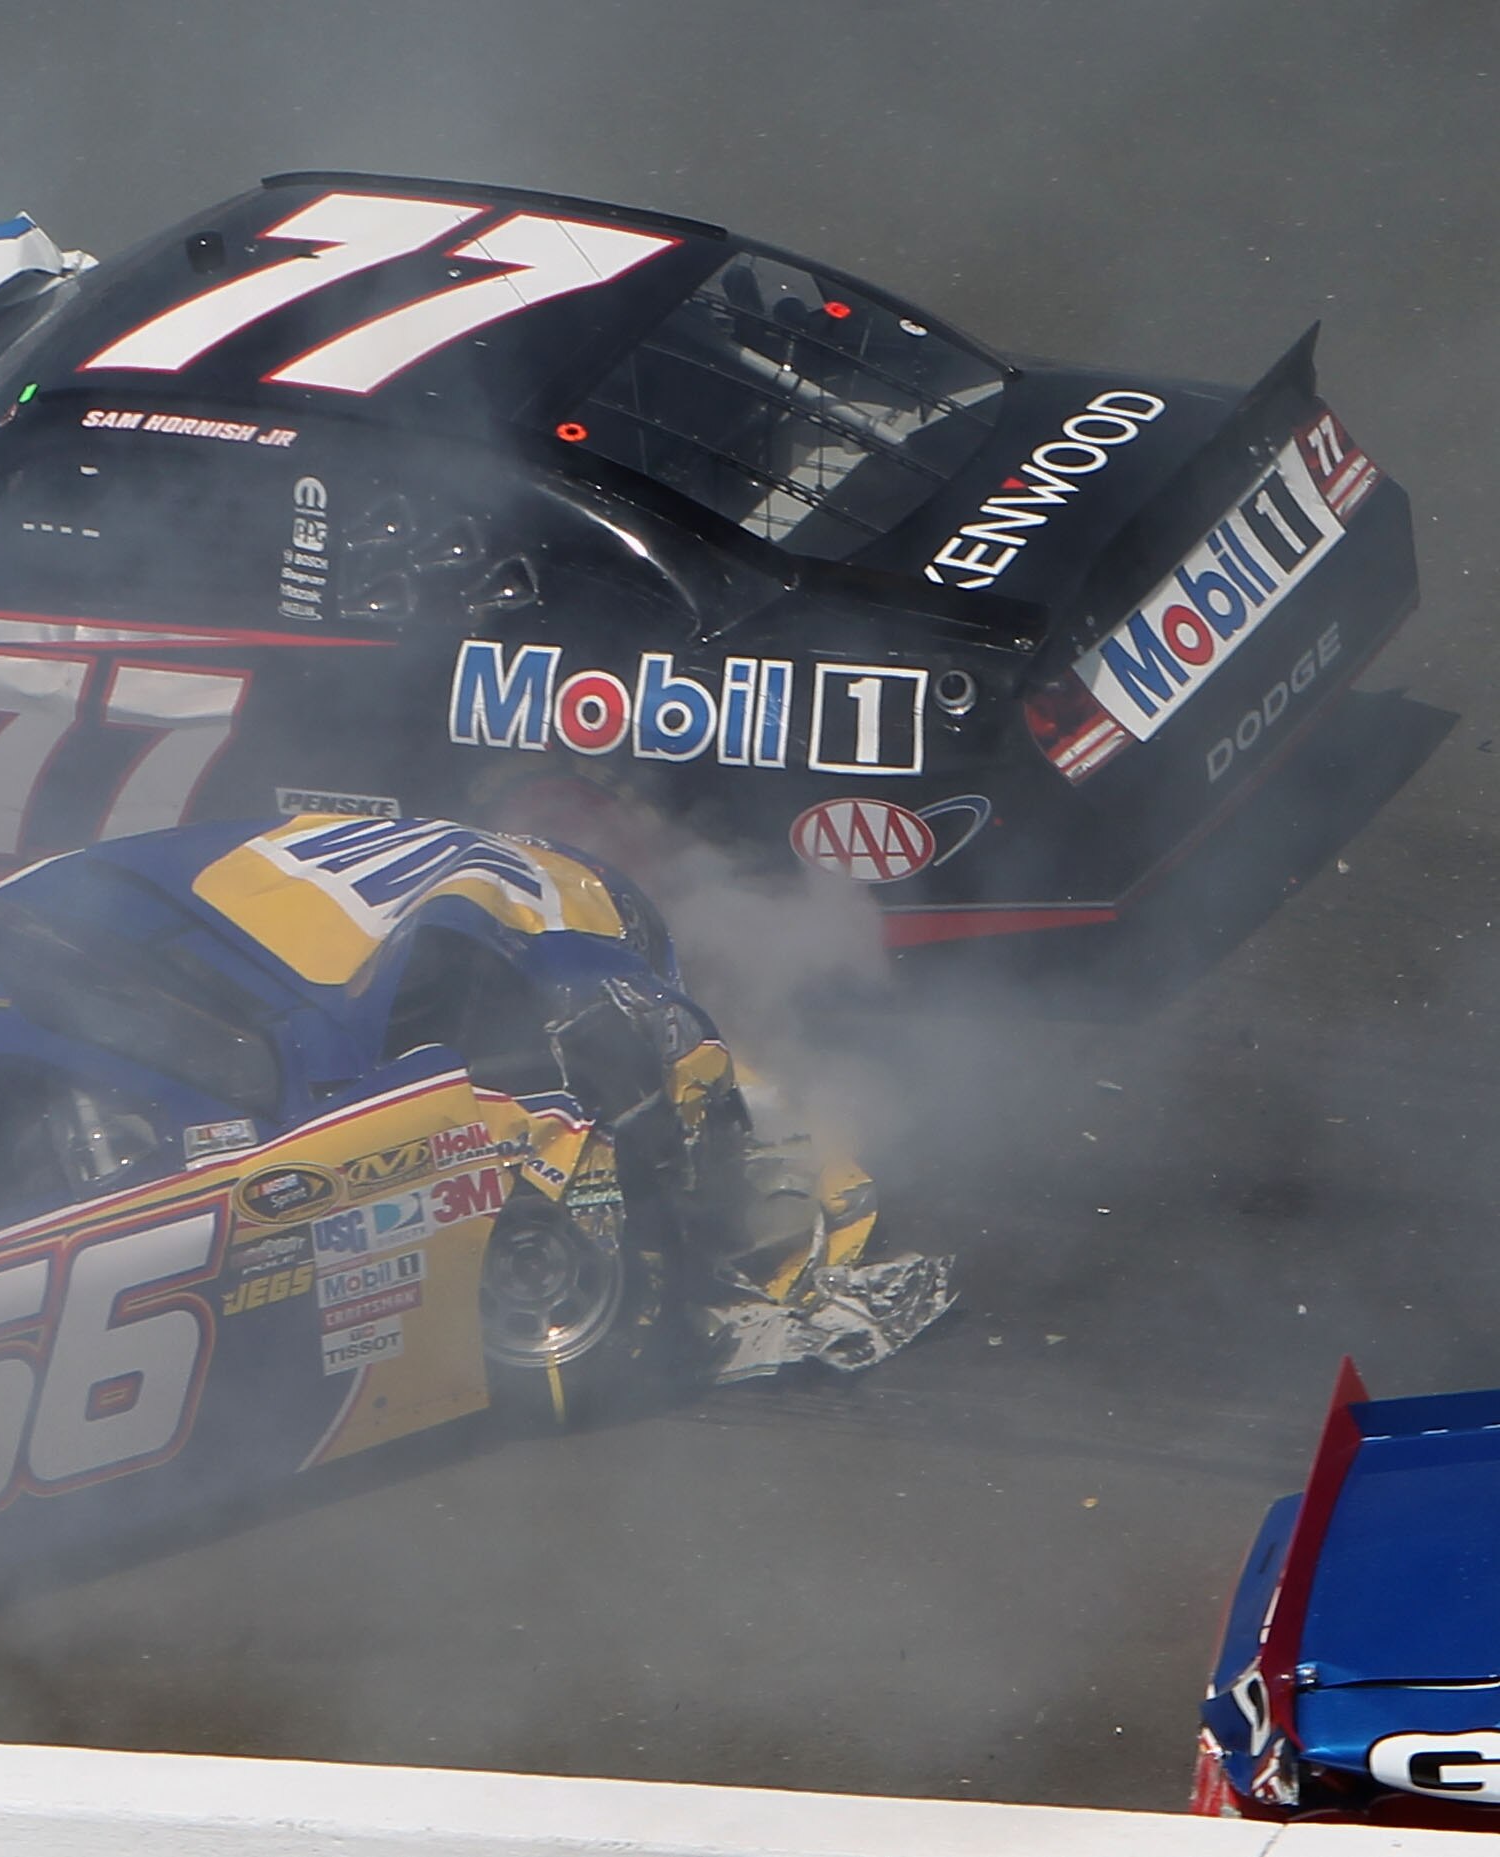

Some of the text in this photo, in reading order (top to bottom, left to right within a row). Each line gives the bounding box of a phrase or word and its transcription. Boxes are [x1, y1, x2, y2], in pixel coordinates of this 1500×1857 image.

[77, 190, 685, 396] 77
[81, 408, 299, 449] SAM HORNISH JR
[1307, 414, 1344, 476] 77
[1101, 518, 1278, 718] Mobil
[449, 639, 883, 768] Mobil 1
[1206, 621, 1342, 785] DODGE
[282, 792, 396, 818] PENSKE
[812, 802, 925, 881] AAA
[431, 1168, 502, 1225] 3M
[222, 1265, 315, 1316] JEGS
[323, 1261, 392, 1301] Mobil
[324, 1331, 402, 1364] TISSOT
